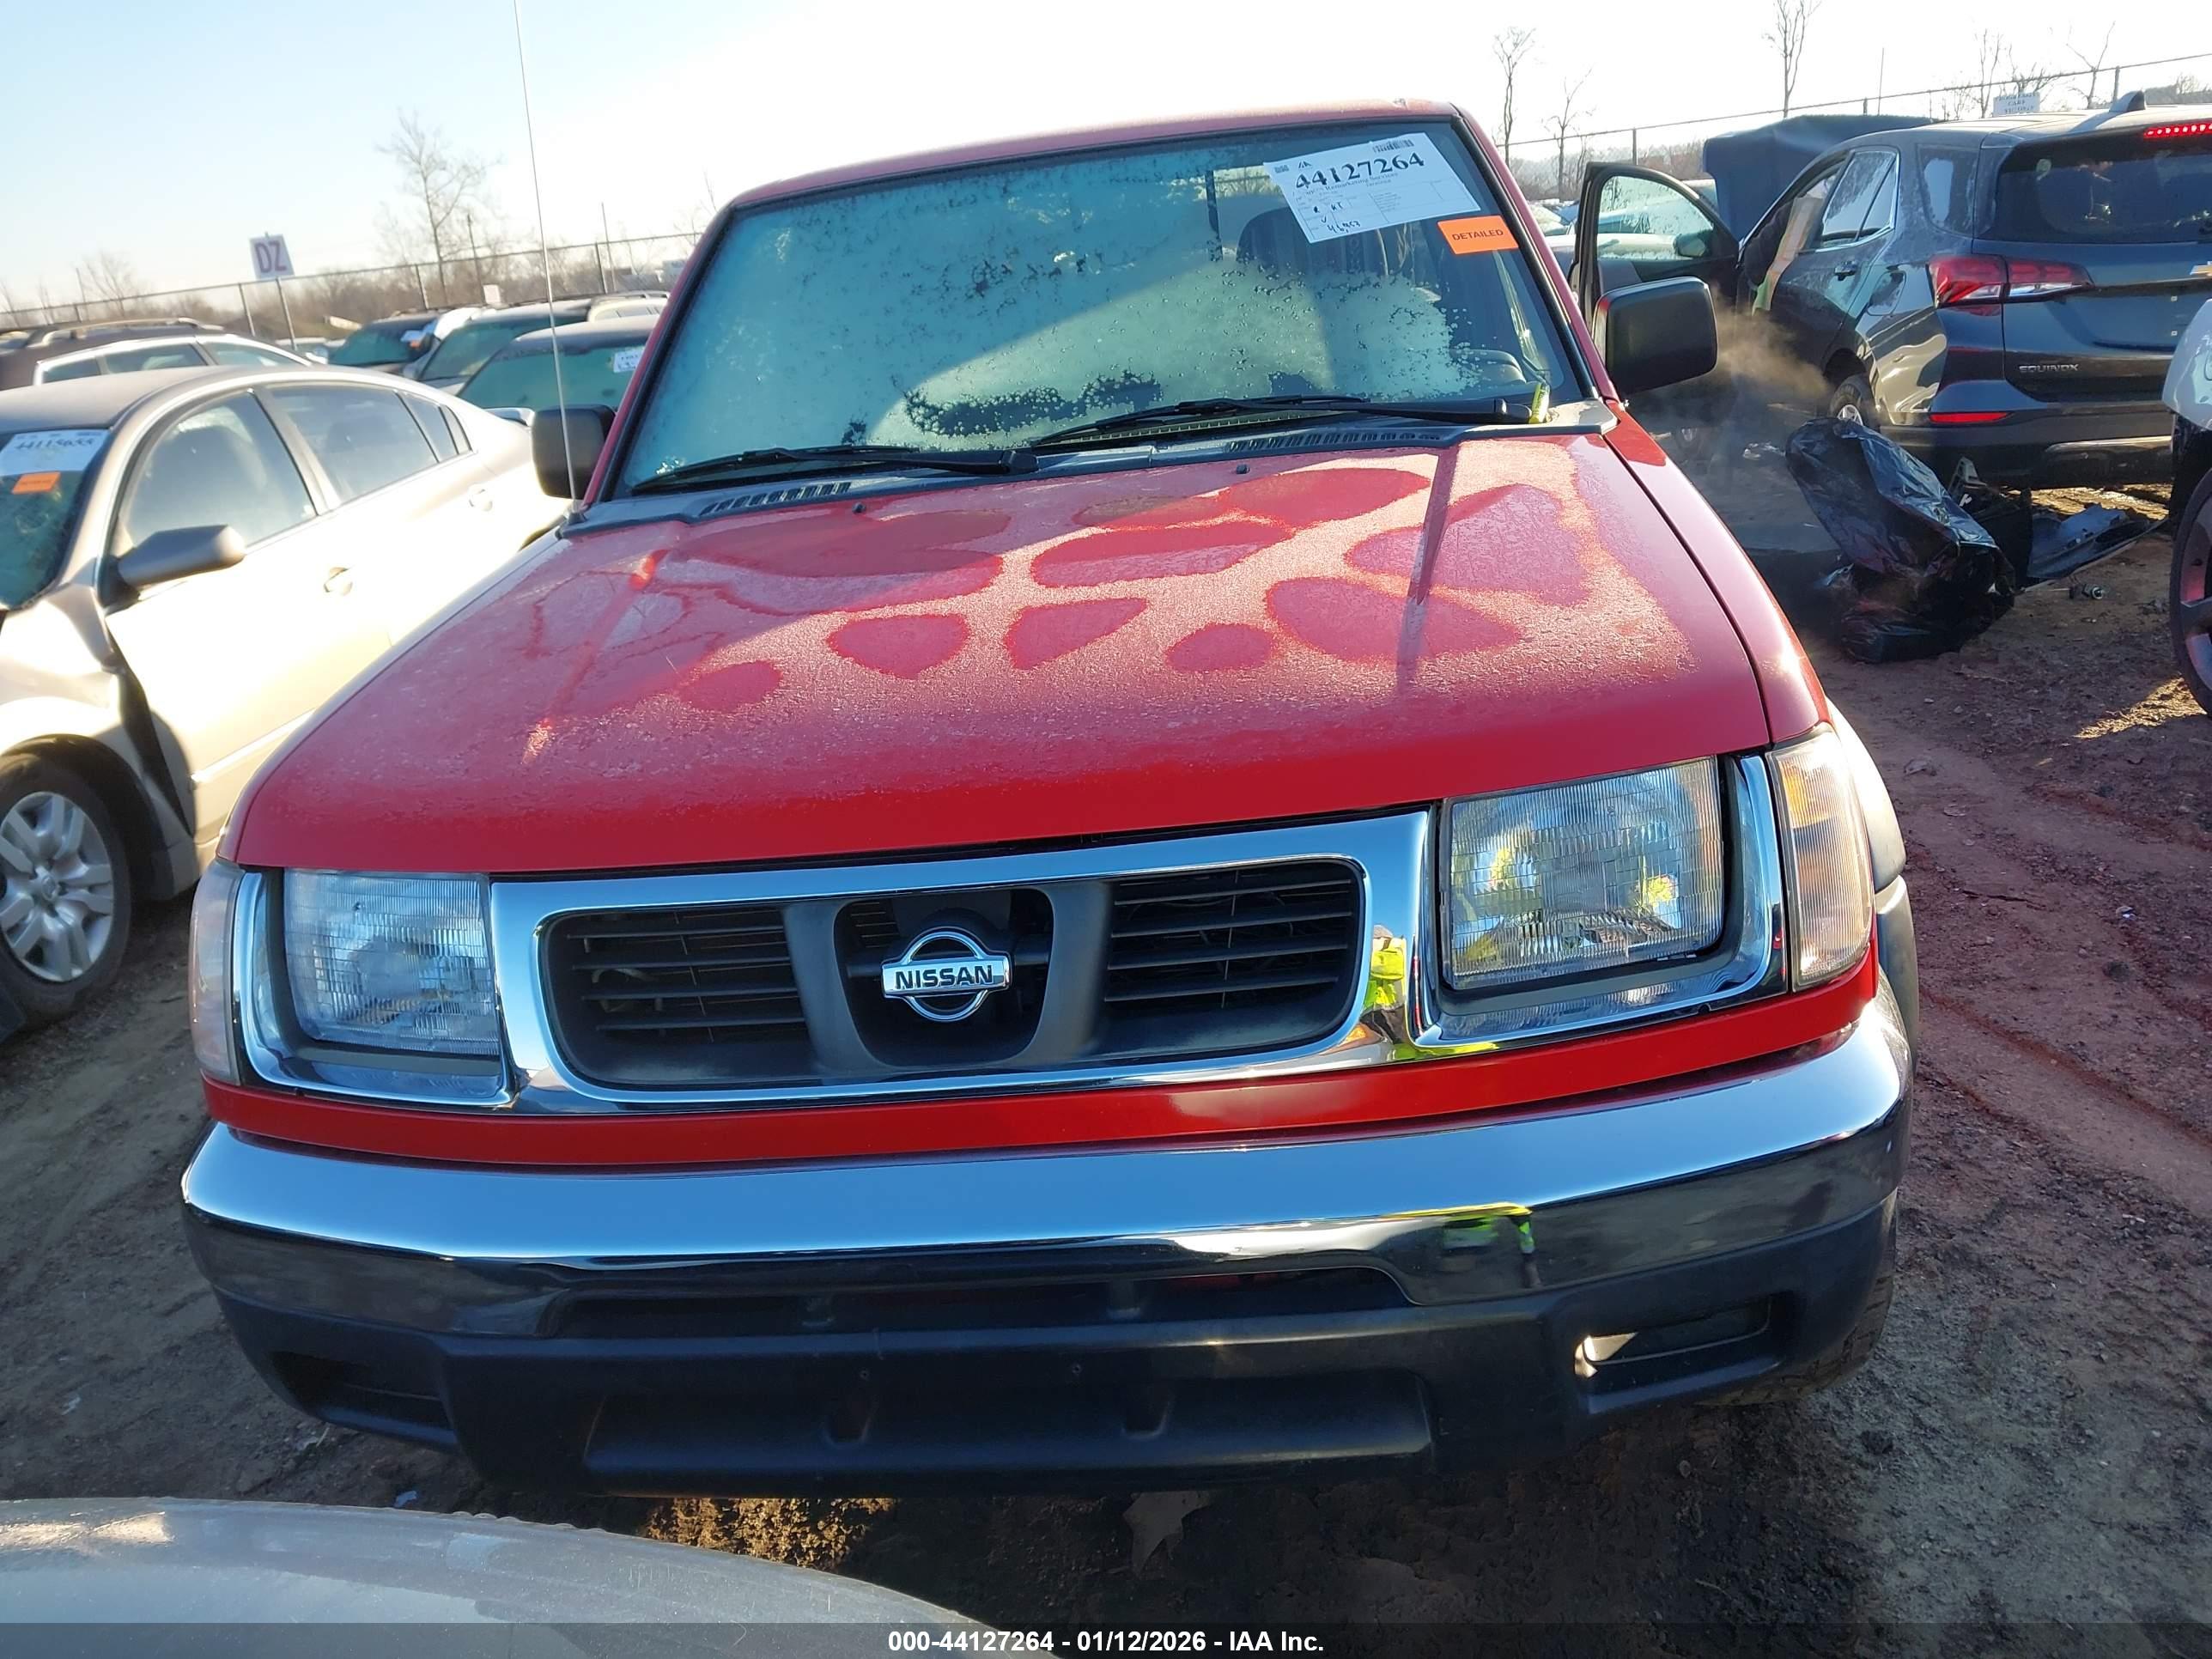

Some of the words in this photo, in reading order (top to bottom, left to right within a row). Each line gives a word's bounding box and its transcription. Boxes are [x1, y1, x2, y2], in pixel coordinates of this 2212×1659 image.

[1296, 152, 1425, 189] 44127264
[1451, 228, 1504, 241] DETAILED
[254, 240, 288, 274] DZ
[2019, 363, 2079, 373] EQUINOX
[895, 964, 993, 989] NISSAN
